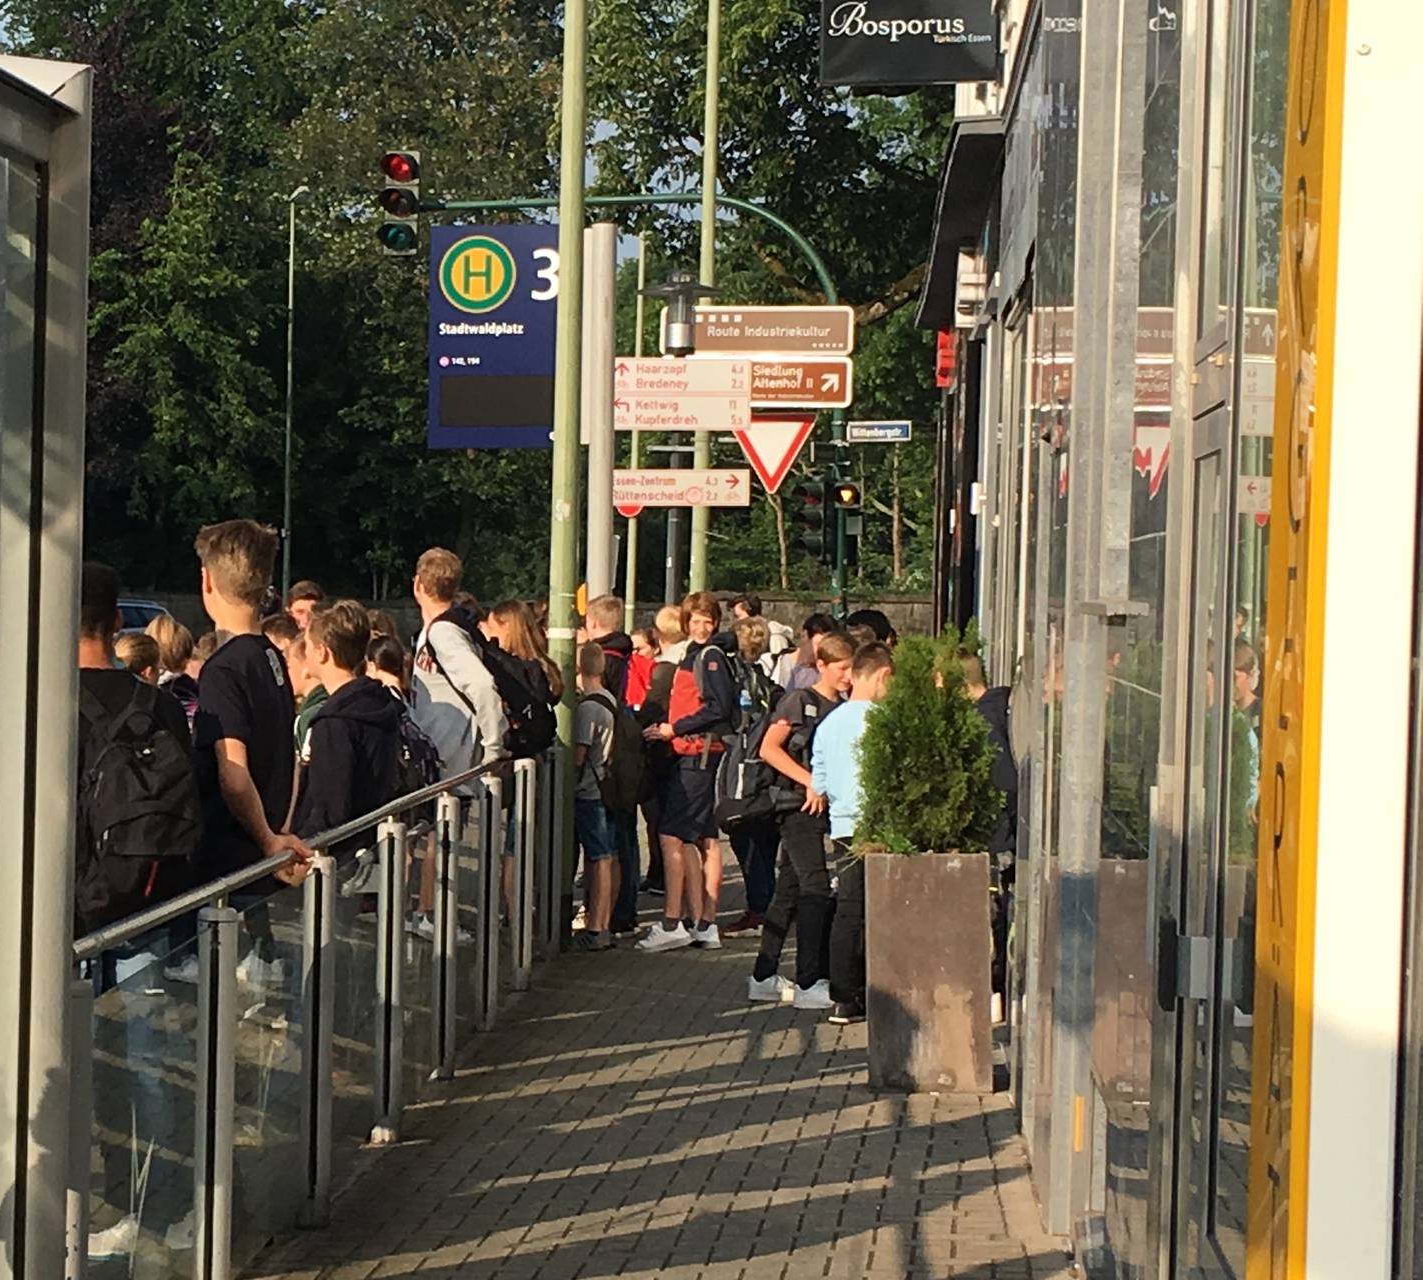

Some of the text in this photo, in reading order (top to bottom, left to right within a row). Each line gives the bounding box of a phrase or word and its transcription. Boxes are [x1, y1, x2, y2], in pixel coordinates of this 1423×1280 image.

[828, 1, 965, 42] Bosporus
[463, 254, 492, 295] H
[531, 248, 560, 300] 3
[439, 322, 524, 336] Stadtwaldplatz
[707, 325, 831, 337] Route Industriekultur
[636, 364, 687, 375] Haarzopf
[752, 364, 803, 377] Siedlung
[635, 378, 689, 390] Bredeney
[752, 377, 802, 389] Altenhof
[635, 400, 679, 412] Kettwig
[635, 414, 698, 427] Kupferdreh
